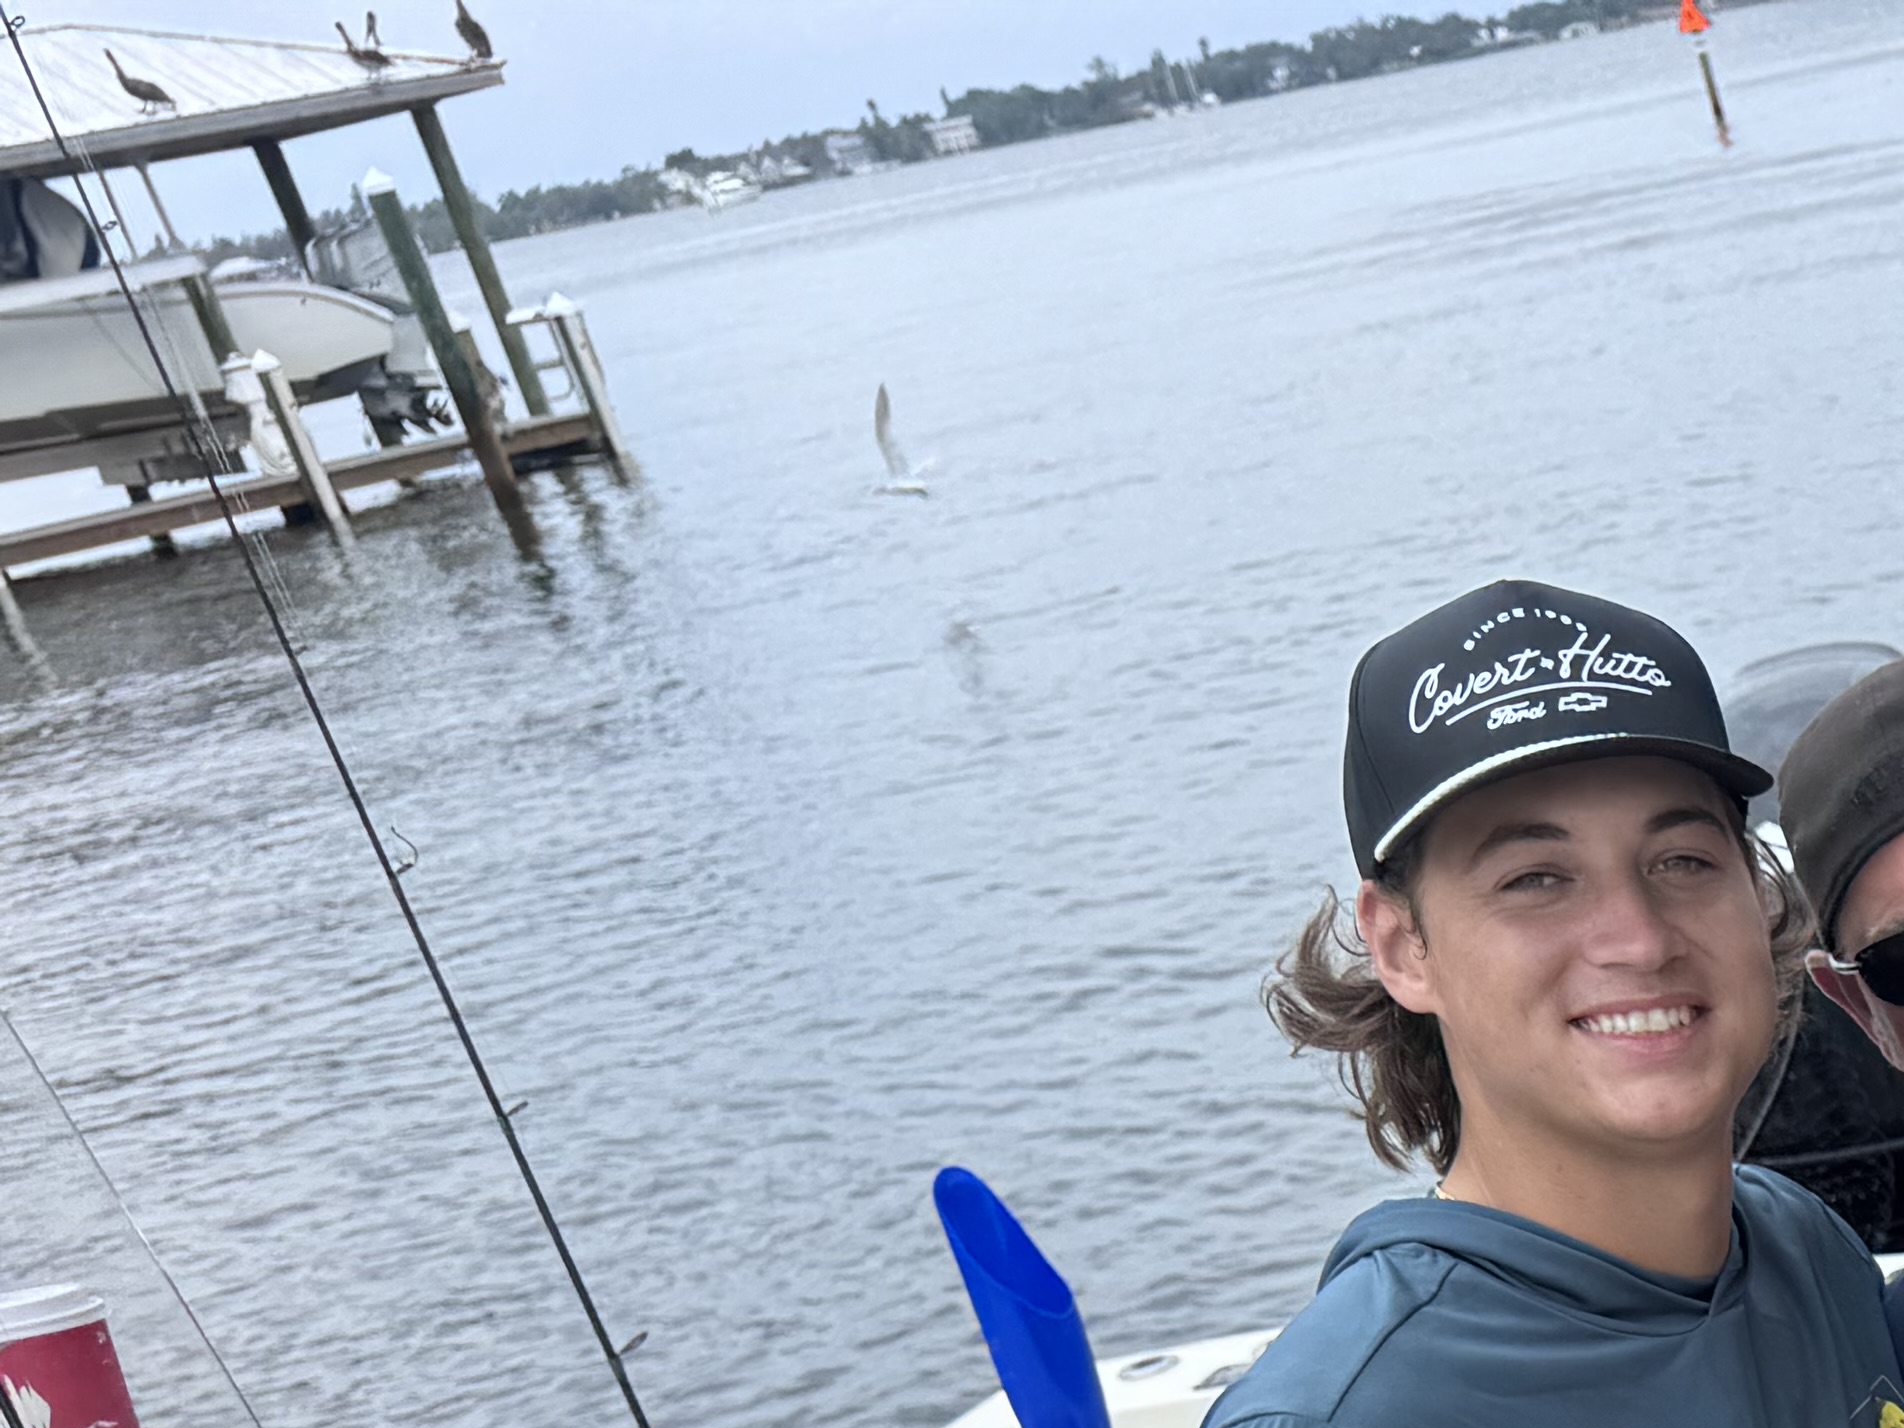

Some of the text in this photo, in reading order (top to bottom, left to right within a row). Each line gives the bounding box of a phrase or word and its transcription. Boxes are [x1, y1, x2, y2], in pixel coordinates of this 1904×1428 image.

[1409, 632, 1672, 733] Covert Hutto
[1487, 701, 1547, 729] Ford
